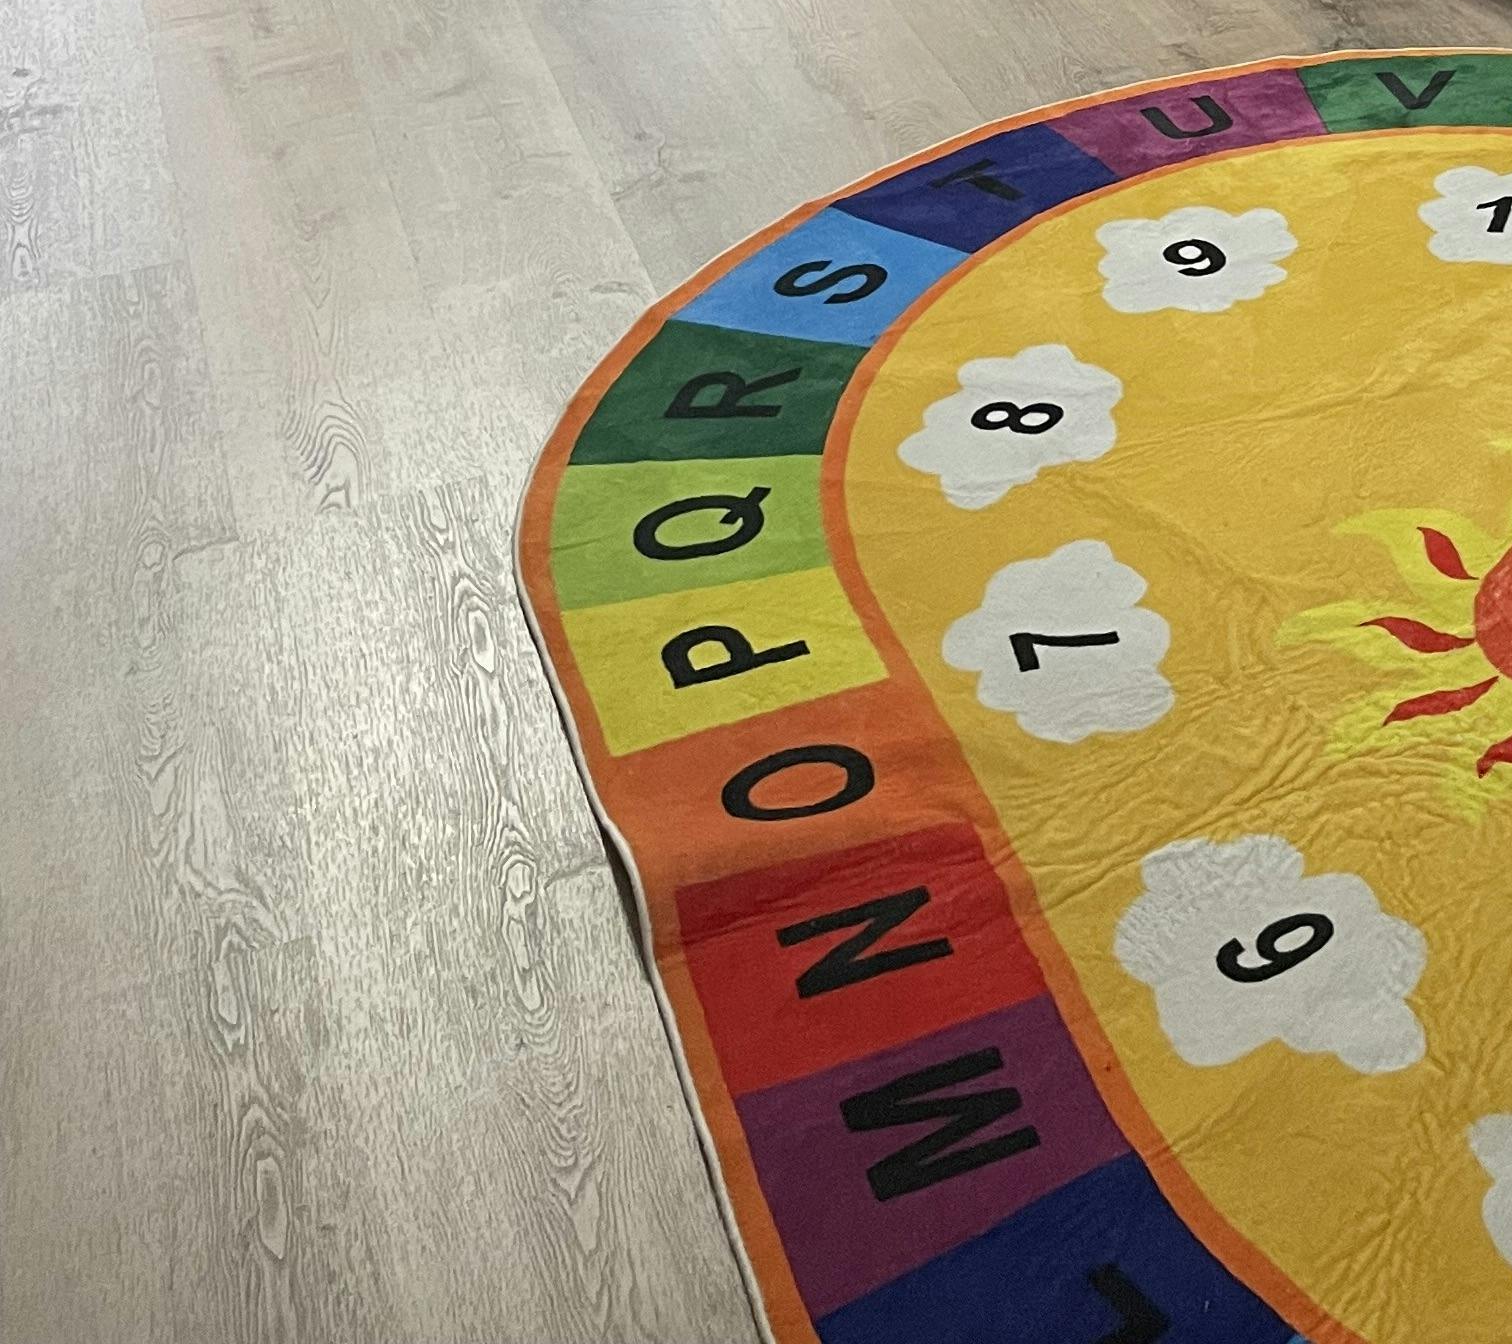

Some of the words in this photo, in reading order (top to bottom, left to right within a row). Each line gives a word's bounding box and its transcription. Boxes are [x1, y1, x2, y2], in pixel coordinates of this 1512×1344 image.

[1376, 69, 1457, 110] V
[1139, 95, 1233, 139] U
[931, 157, 1025, 201] T
[773, 259, 889, 305] S
[1162, 238, 1227, 277] 9
[662, 367, 802, 420] R
[970, 401, 1065, 435] 8
[633, 485, 772, 562] Q
[660, 624, 811, 689] P
[1007, 629, 1120, 673] 7
[720, 743, 877, 822] O
[775, 885, 955, 1000] N
[1215, 912, 1336, 984] 6
[840, 1047, 1042, 1203] M
